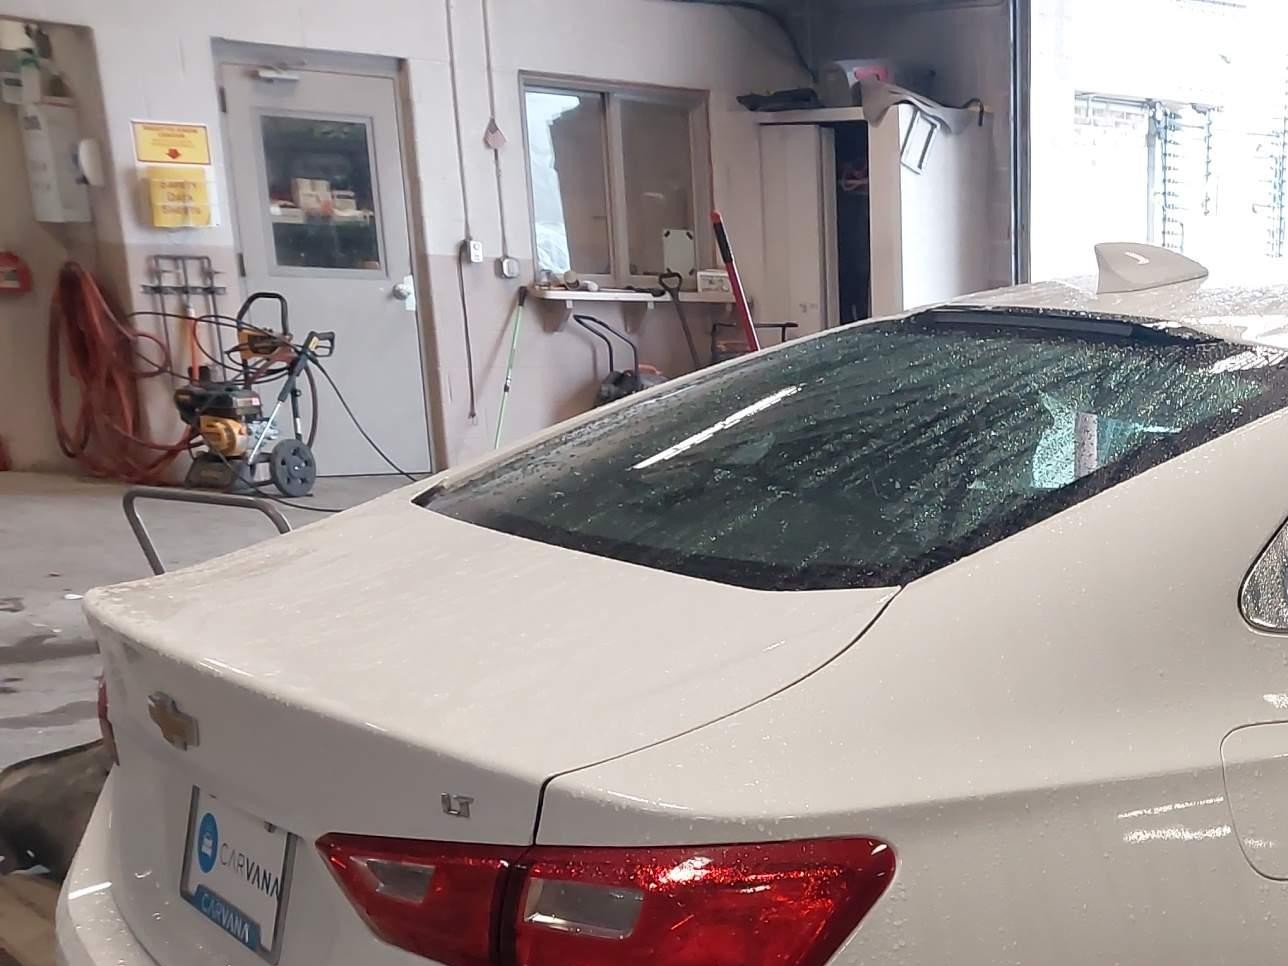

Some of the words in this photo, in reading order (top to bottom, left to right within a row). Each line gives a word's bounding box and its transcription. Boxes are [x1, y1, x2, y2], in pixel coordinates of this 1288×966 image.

[441, 792, 474, 818] LT
[219, 843, 281, 897] CARVANA
[201, 893, 250, 943] CARVANA
